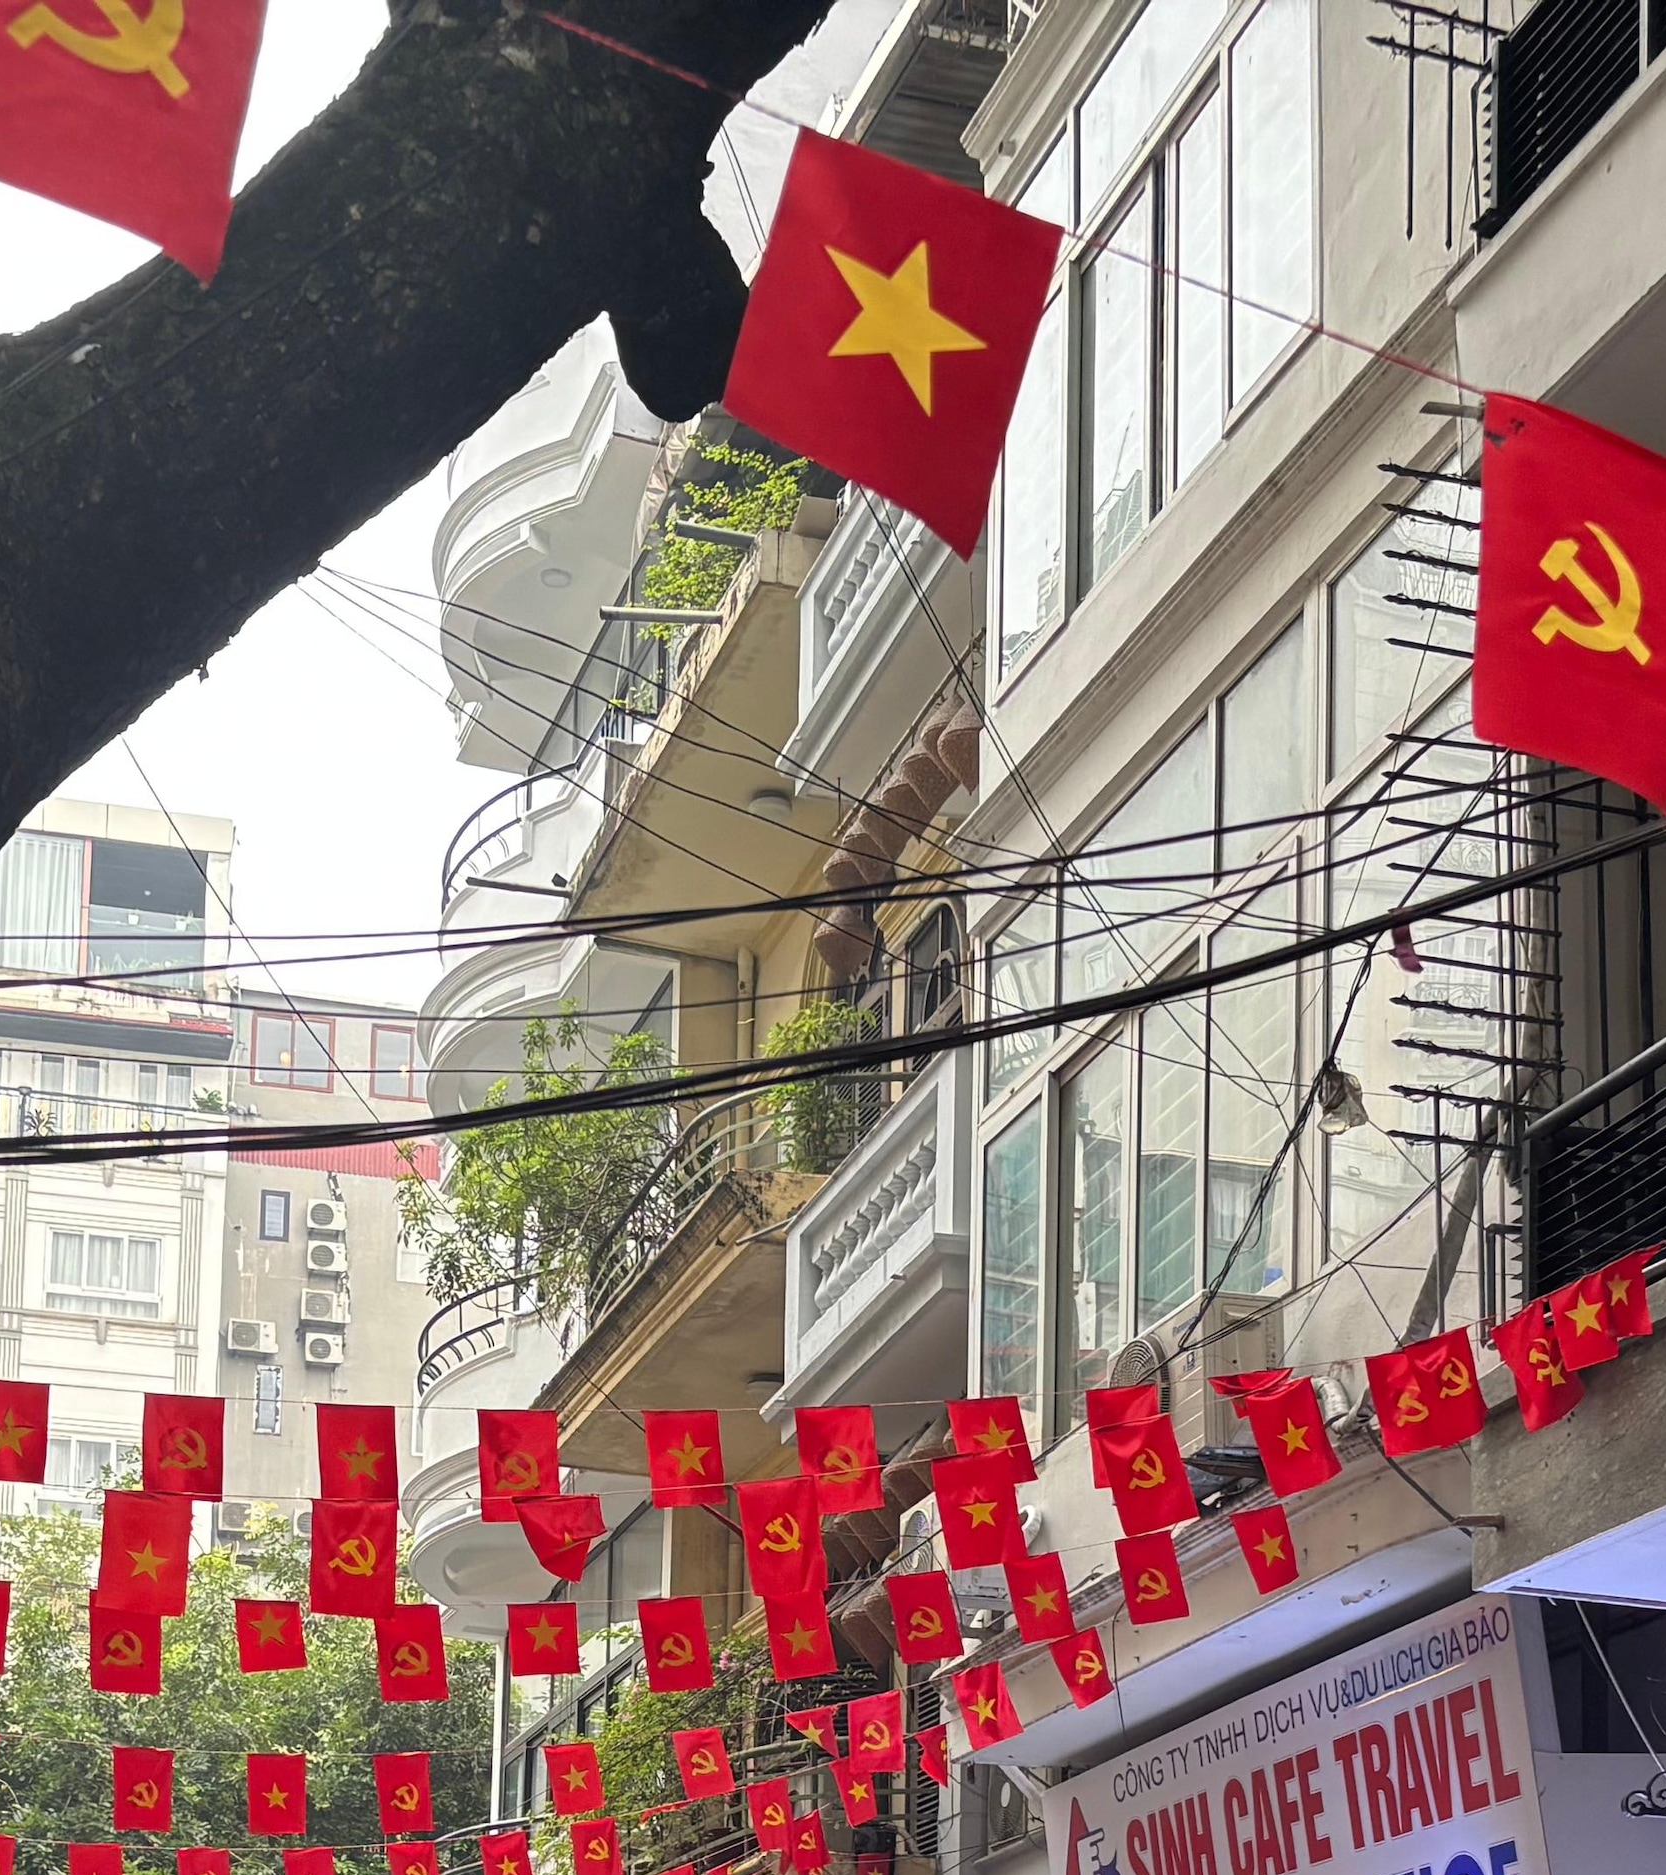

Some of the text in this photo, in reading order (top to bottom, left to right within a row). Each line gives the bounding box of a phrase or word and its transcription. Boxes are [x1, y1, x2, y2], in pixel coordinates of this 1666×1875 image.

[1113, 1605, 1511, 1804] CÔNG TY TNHH DỊCH GIA BẢO
[1334, 1678, 1523, 1851] TRAVEL
